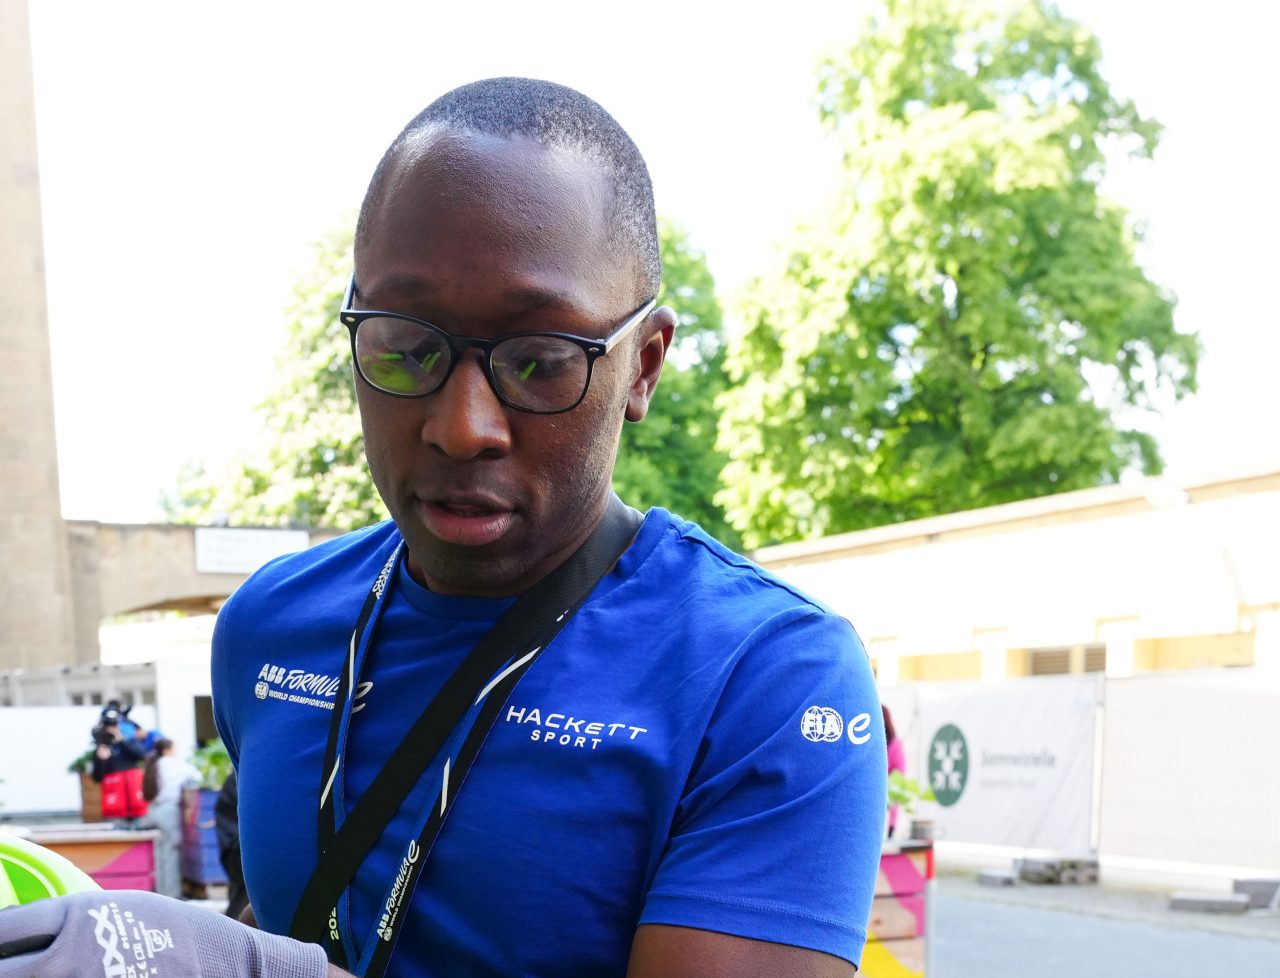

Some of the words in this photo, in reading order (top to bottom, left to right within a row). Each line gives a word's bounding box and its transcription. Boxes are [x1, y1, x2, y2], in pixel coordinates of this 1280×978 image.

[258, 663, 286, 685] ABB
[269, 690, 288, 701] WORLD
[506, 705, 648, 740] HACKETT
[803, 711, 841, 735] FIA
[530, 729, 602, 750] SPORT
[376, 913, 390, 938] ABB
[385, 857, 410, 916] FORMULA
